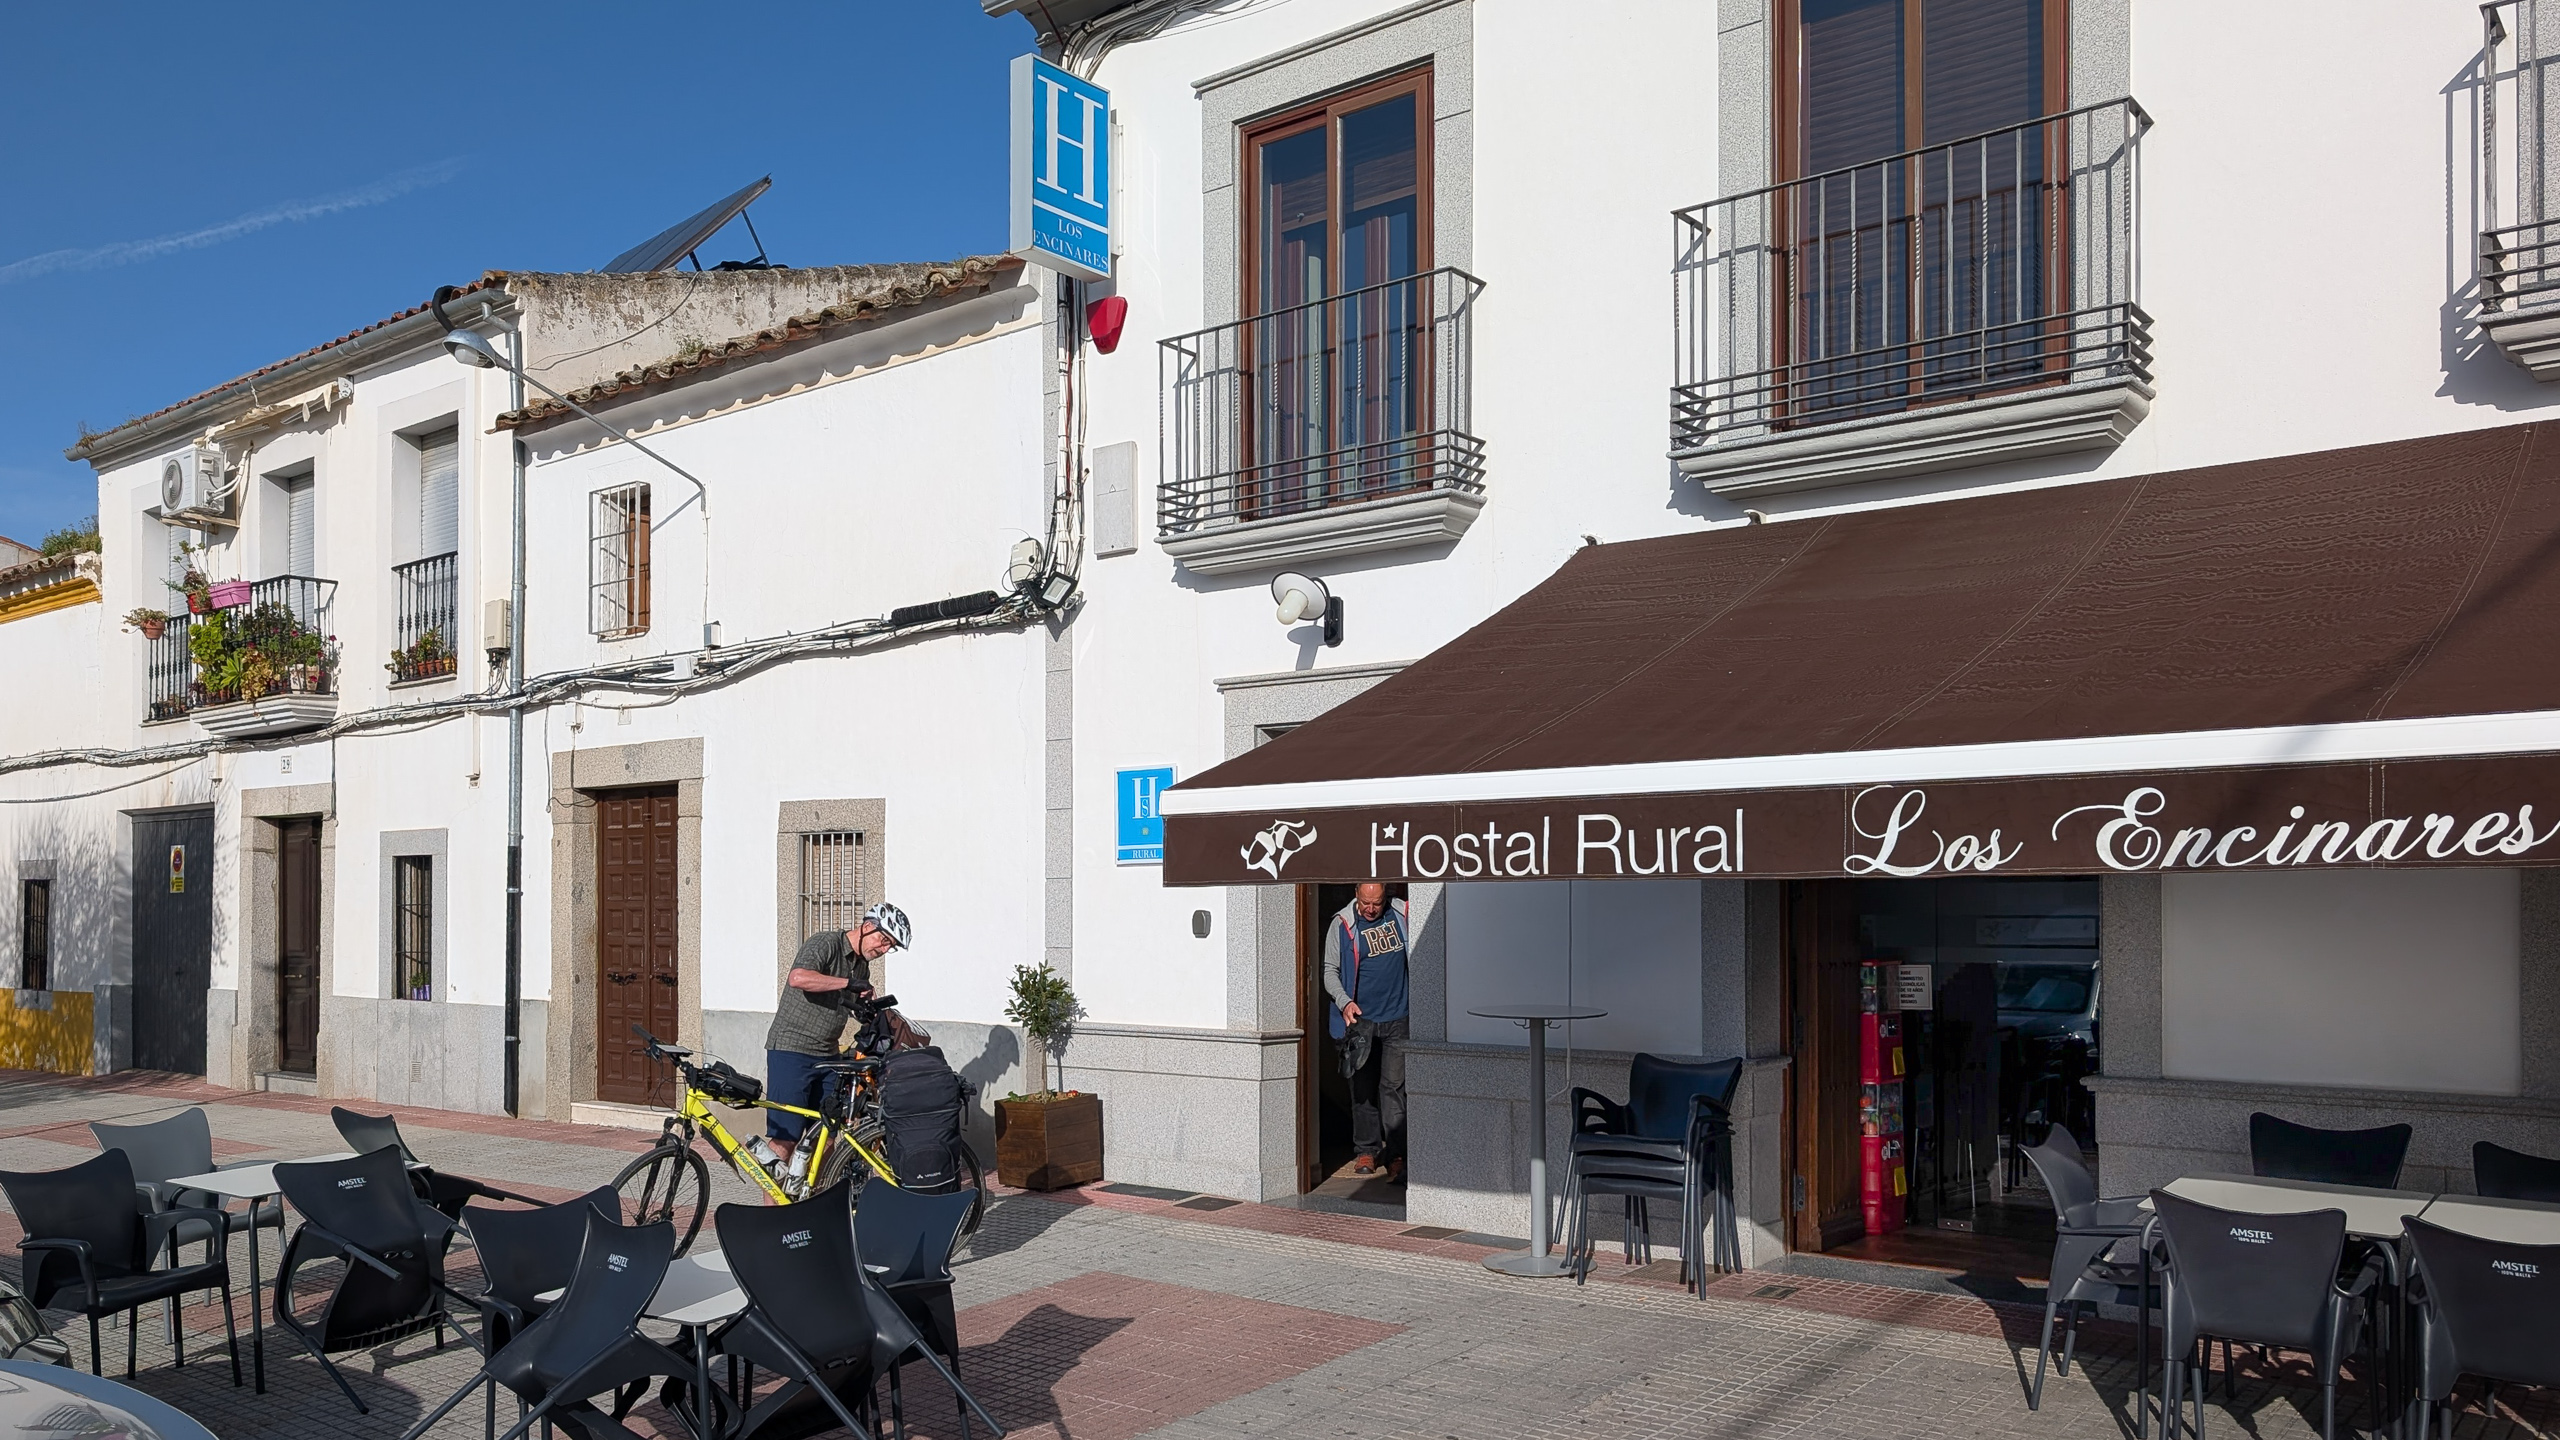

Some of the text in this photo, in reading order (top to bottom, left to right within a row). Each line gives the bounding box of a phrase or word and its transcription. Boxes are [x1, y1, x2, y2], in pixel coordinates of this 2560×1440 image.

[1037, 73, 1104, 209] H
[1058, 219, 1083, 240] LOS
[1033, 230, 1108, 269] ENCINARES
[1132, 776, 1159, 819] H
[1369, 784, 2560, 878] Hostal Rural Los Encinares
[1132, 849, 1160, 859] RURAL
[338, 1177, 367, 1187] AMSTEL
[782, 1230, 812, 1244] AMSTEL
[2230, 1228, 2273, 1240] AMSTEL
[608, 1253, 629, 1268] AMSTEL
[2492, 1260, 2540, 1274] AMSTEL
